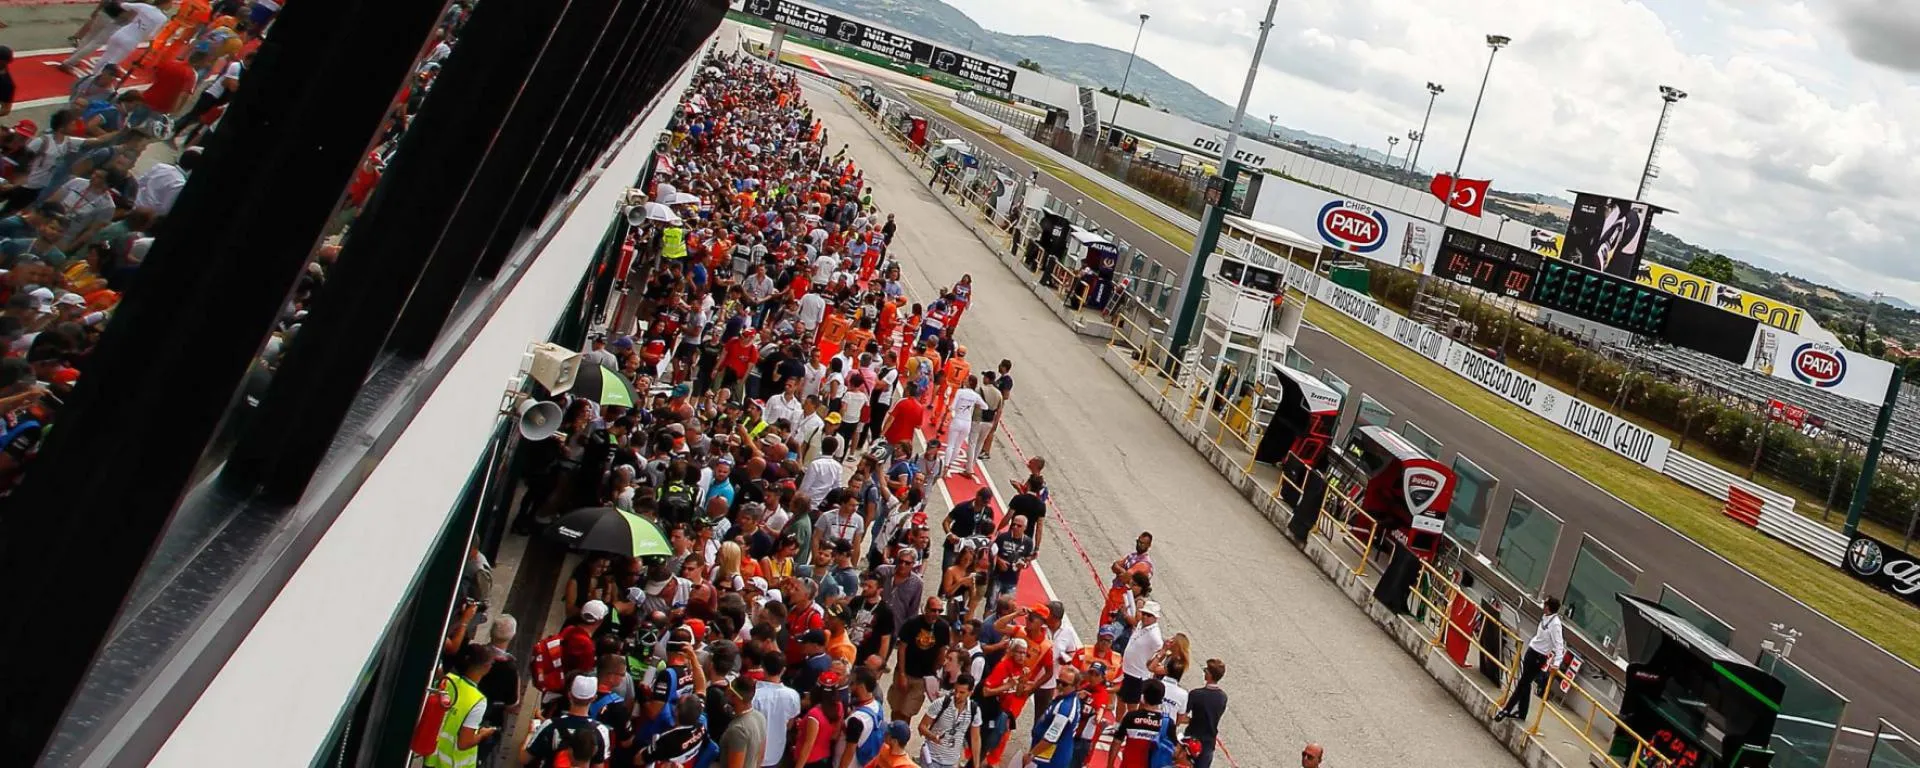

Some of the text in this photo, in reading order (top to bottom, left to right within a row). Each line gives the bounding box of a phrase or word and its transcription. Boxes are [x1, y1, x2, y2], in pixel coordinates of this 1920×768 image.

[775, 14, 827, 35] on board cam
[861, 39, 911, 60] on board cam
[959, 69, 1008, 89] on board cam
[1193, 137, 1266, 166] COLCEM
[1345, 201, 1371, 215] CHIPS
[1331, 213, 1371, 240] PATA
[1659, 273, 1712, 302] eni
[1331, 287, 1380, 326] PROSECCO DOC
[1750, 301, 1801, 332] eni
[1460, 351, 1536, 406] PROSECCO DOC
[1802, 354, 1833, 376] PATA
[1564, 400, 1654, 463] ITALIAN GENIO
[1411, 476, 1436, 488] DUCATI
